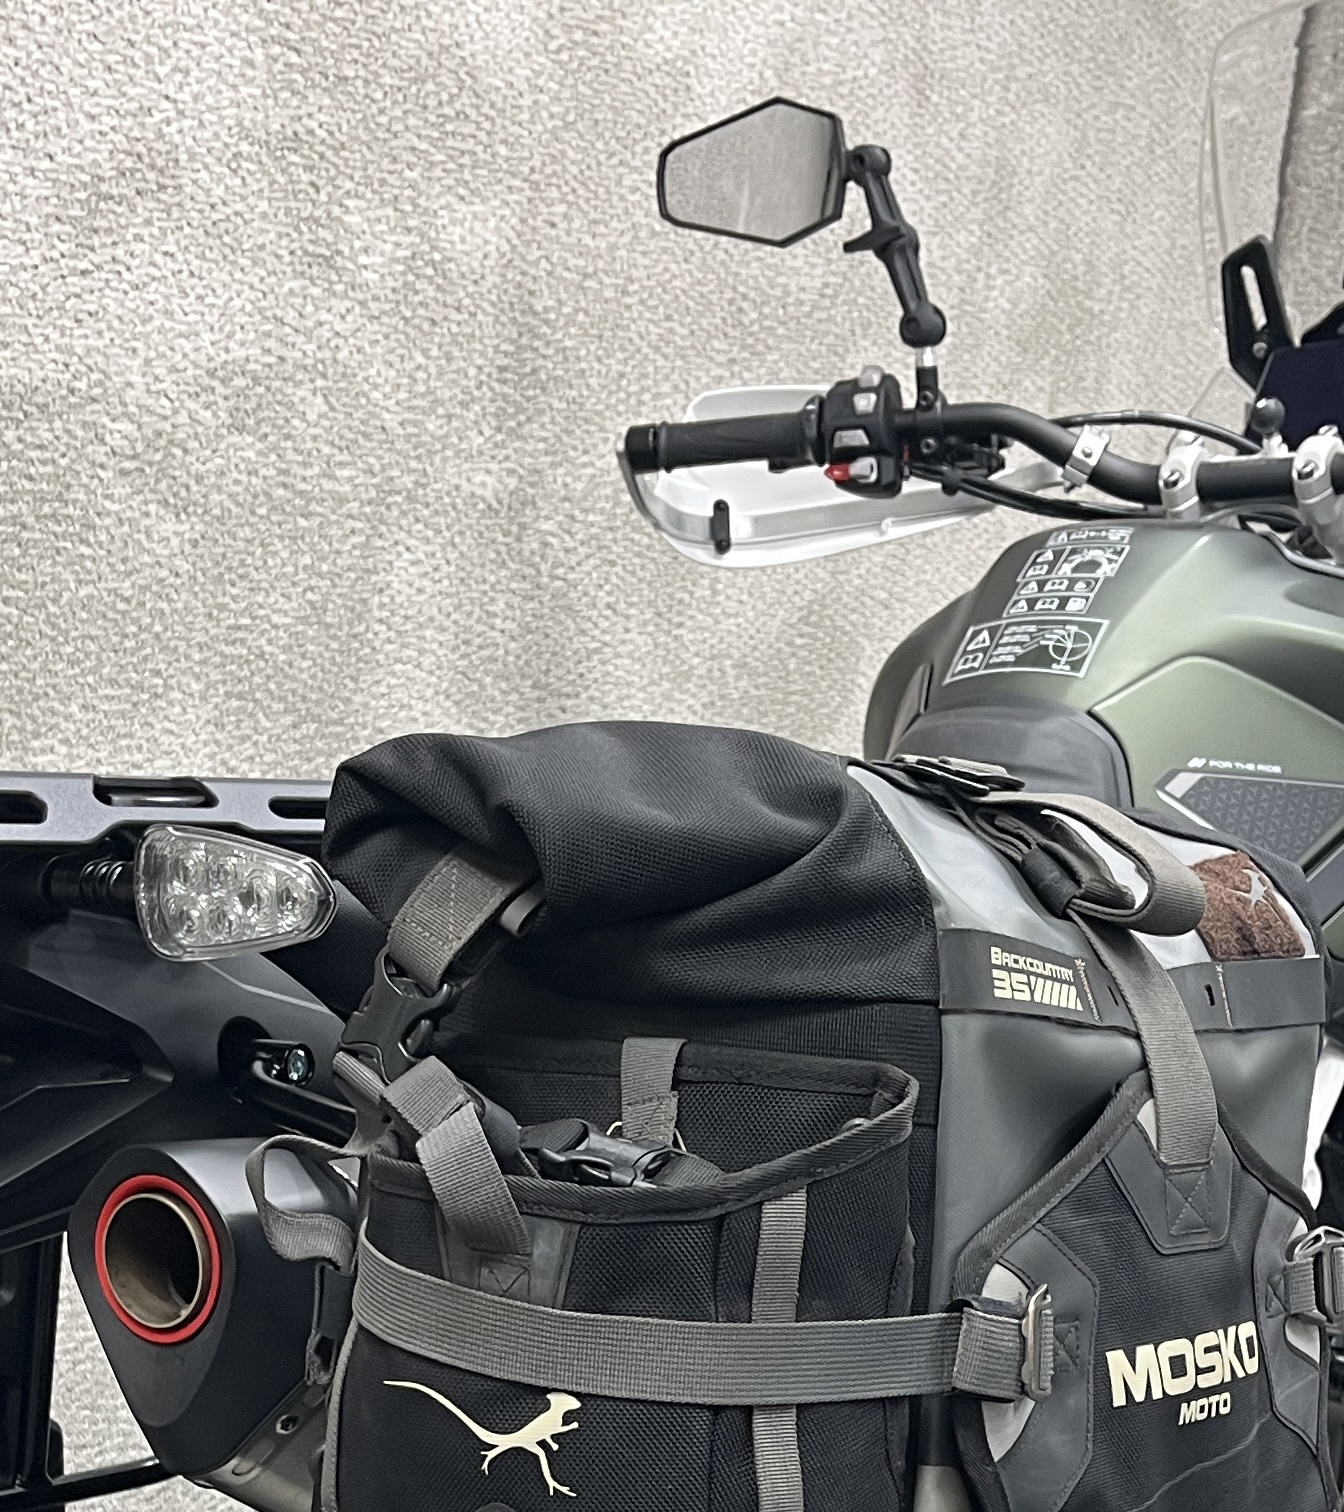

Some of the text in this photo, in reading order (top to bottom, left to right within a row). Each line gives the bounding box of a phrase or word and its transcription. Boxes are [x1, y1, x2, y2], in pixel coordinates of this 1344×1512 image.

[1234, 762, 1255, 771] THE
[992, 968, 1031, 1001] 35
[1105, 1320, 1259, 1408] MOSKO
[1177, 1391, 1231, 1426] MOTO
